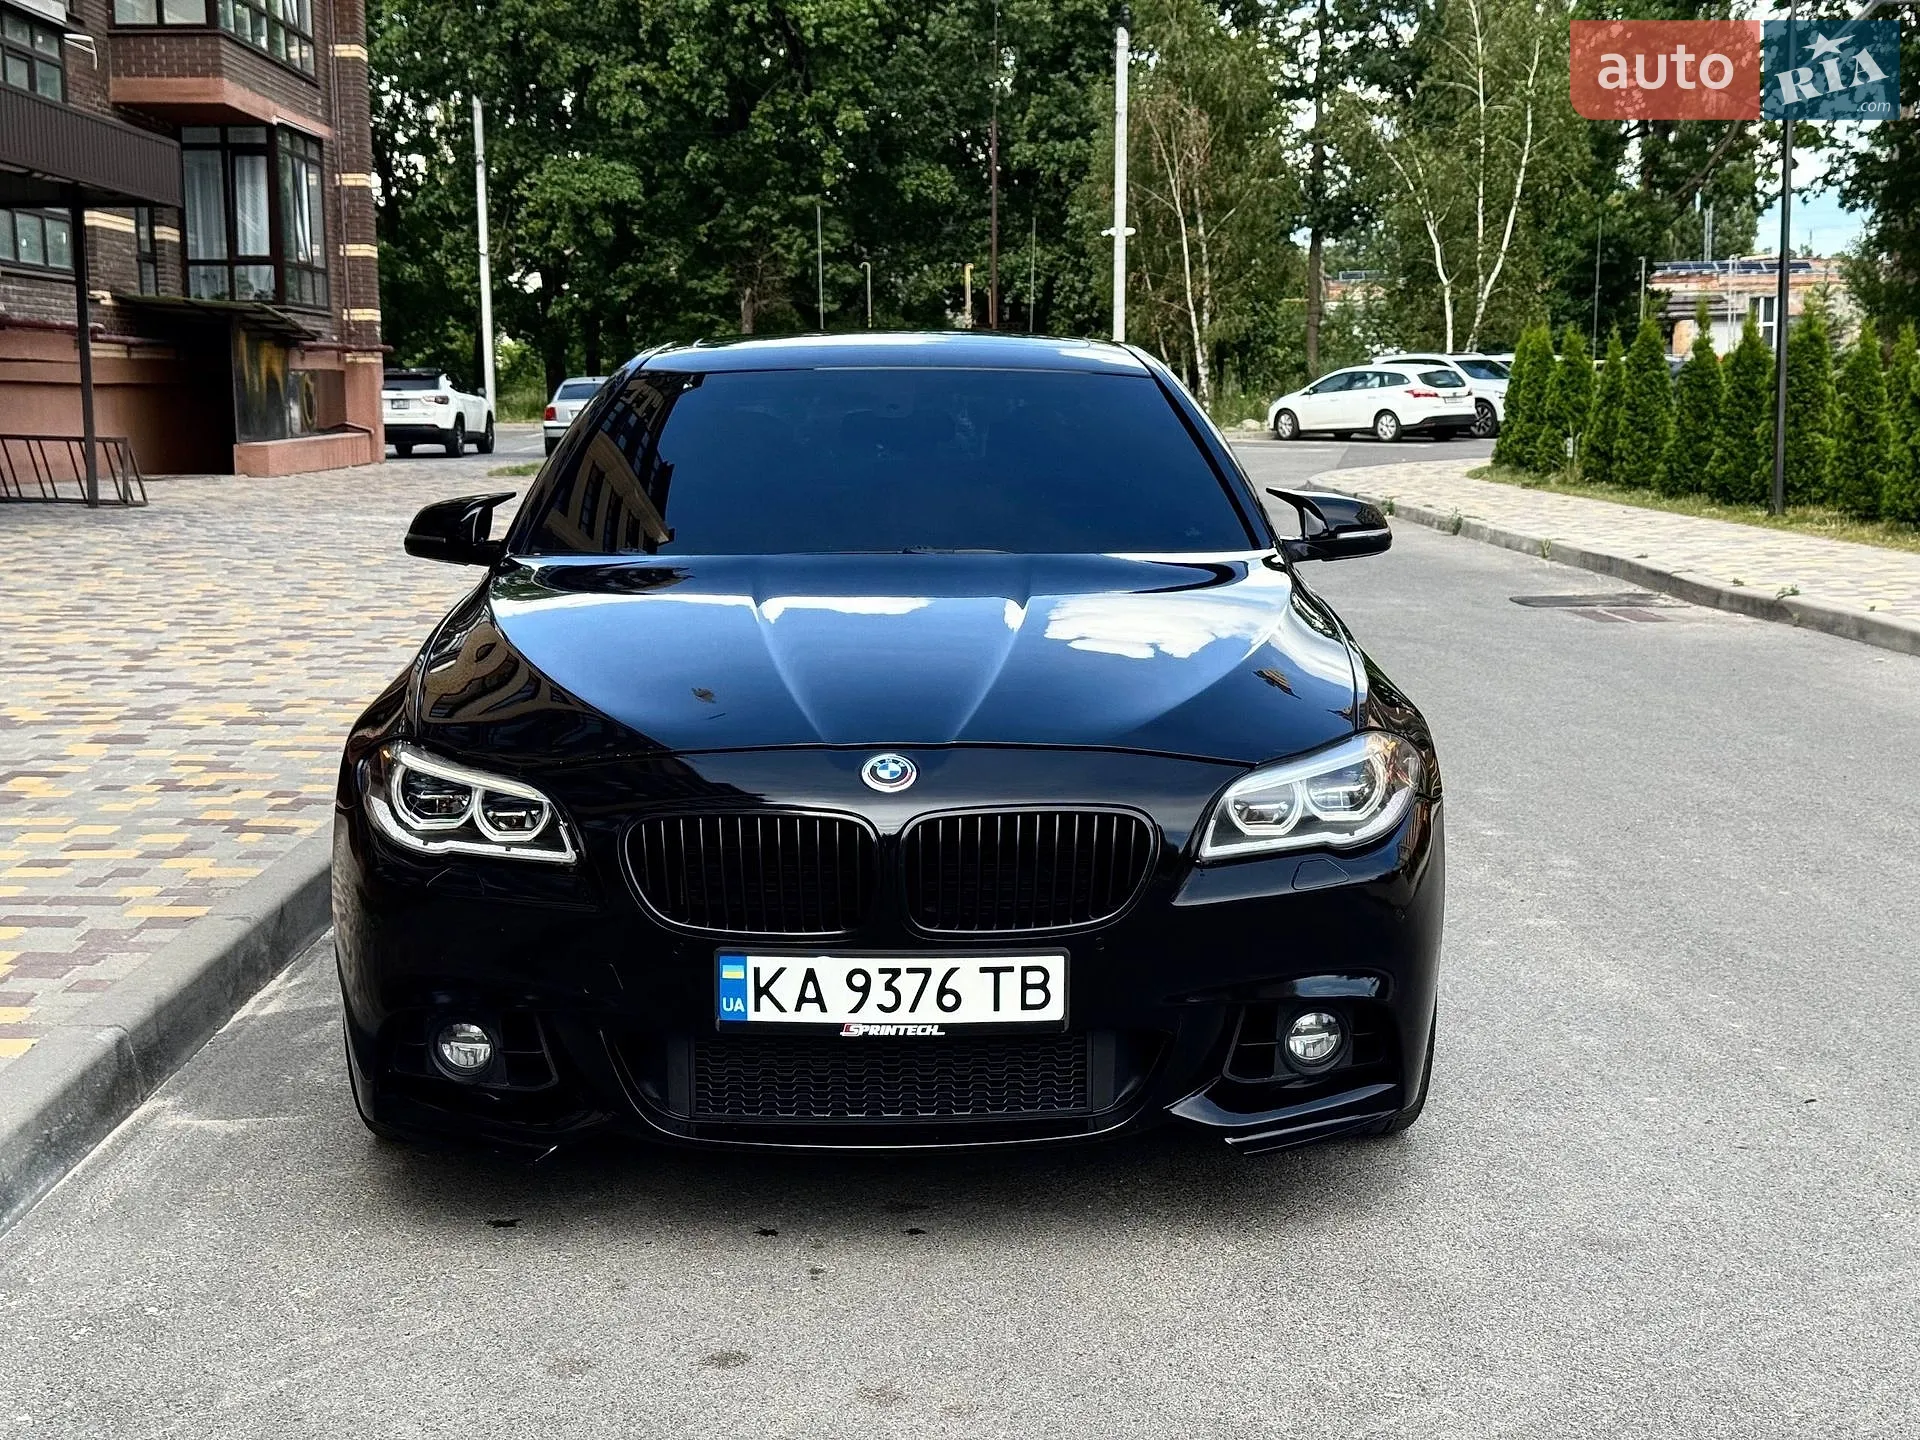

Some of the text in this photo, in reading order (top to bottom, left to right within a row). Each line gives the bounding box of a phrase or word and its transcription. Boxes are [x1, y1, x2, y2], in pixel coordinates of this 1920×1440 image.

[722, 997, 745, 1012] UA
[753, 965, 1052, 1014] KA 9376 TB
